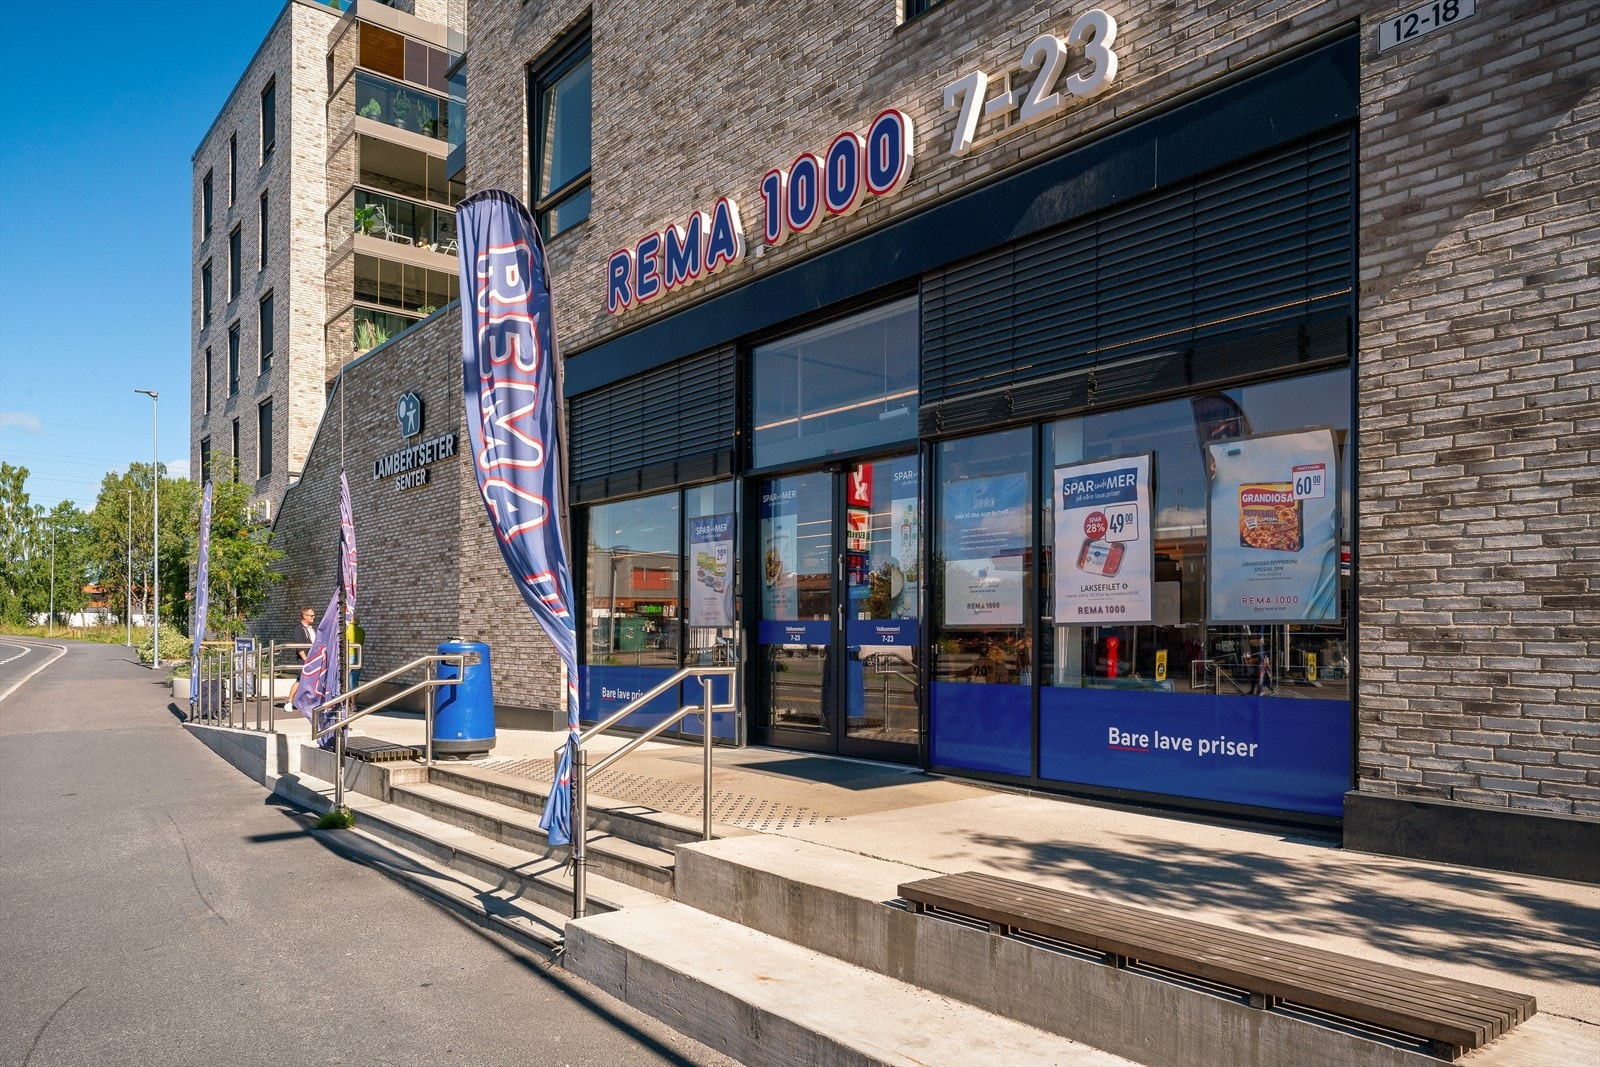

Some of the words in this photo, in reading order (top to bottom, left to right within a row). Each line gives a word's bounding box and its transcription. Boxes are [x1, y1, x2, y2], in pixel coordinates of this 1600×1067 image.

[1393, 0, 1460, 42] 12-18
[943, 9, 1118, 157] 7-23
[607, 197, 744, 316] REMA
[760, 108, 911, 245] 1000
[477, 240, 550, 543] REMA
[373, 434, 455, 481] LAMBERTSETER
[395, 468, 427, 491] SENTER
[894, 470, 913, 482] SPAR
[1063, 480, 1094, 496] SPAR
[1106, 473, 1136, 490] MER
[1296, 476, 1312, 495] 60
[1242, 493, 1294, 503] GRANDIOSA
[1088, 516, 1103, 524] SPAR
[1109, 513, 1124, 534] 49
[695, 525, 711, 535] SPAR
[714, 523, 728, 533] MER
[1086, 523, 1106, 534] 28%
[1080, 583, 1120, 592] LAKSEFILET
[967, 602, 985, 610] REMA
[1242, 597, 1272, 605] REMA
[1274, 596, 1299, 604] 1000
[1078, 606, 1104, 615] REMA
[1105, 605, 1126, 614] 1000
[882, 635, 895, 643] 7-23
[602, 686, 616, 699] Bare
[617, 687, 630, 700] lave
[1108, 726, 1149, 748] Bare
[1154, 730, 1193, 752] lave
[1198, 735, 1258, 757] priser
